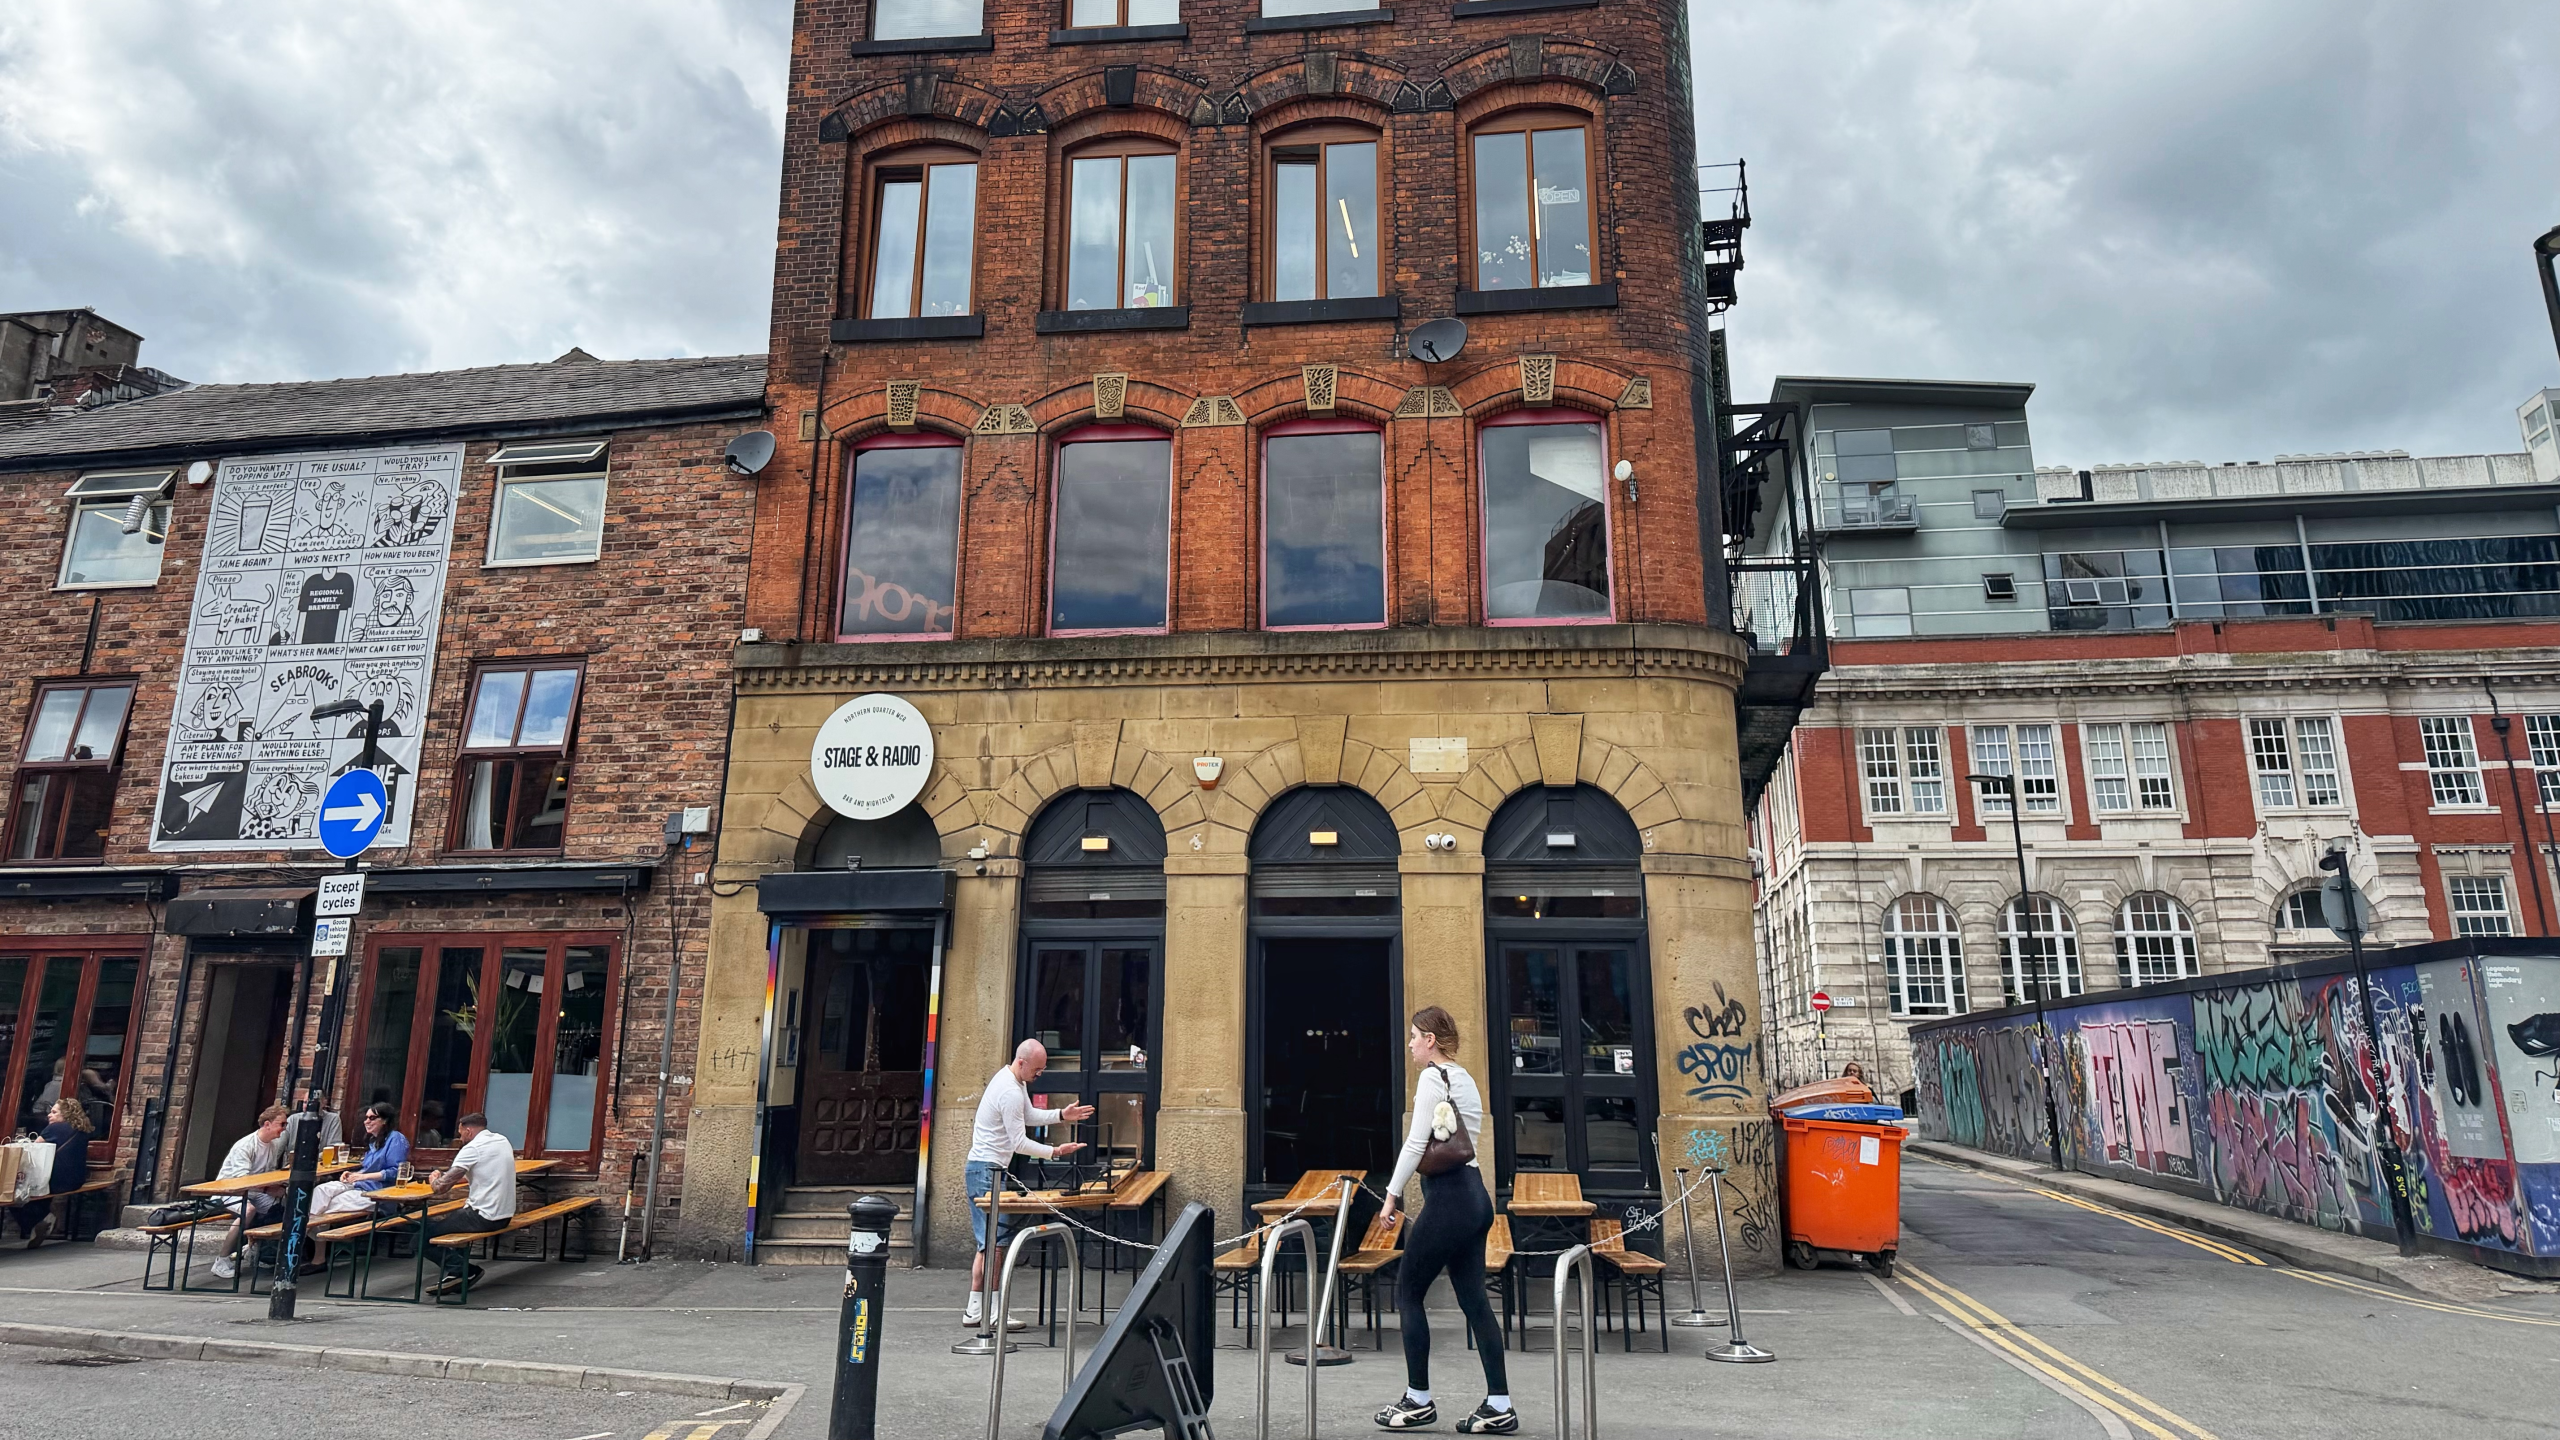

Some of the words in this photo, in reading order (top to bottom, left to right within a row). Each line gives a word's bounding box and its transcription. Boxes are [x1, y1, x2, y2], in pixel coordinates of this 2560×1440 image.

[1546, 190, 1578, 202] OPEN
[384, 457, 409, 466] WOULD
[410, 456, 424, 464] YOU
[260, 464, 281, 472] WANT
[311, 463, 329, 473] THE
[331, 462, 366, 472] USUAL?
[399, 462, 428, 471] TRAY?
[232, 472, 268, 480] TOPPING
[402, 476, 416, 484] okay
[262, 482, 288, 492] perfect
[304, 480, 316, 488] Yes
[309, 538, 328, 547] seen!
[337, 536, 360, 545] exist!
[294, 555, 320, 564] WHO'S
[322, 553, 350, 562] NEXT?
[364, 552, 382, 560] HOW
[383, 551, 402, 559] HAVE
[403, 550, 417, 558] YOU
[418, 549, 440, 558] BEEN?
[218, 560, 240, 568] SAME
[242, 558, 272, 567] AGAIN?
[286, 572, 296, 580] He
[368, 566, 392, 576] Can't
[395, 566, 426, 576] complain
[213, 575, 236, 583] Please
[282, 586, 300, 596] first
[309, 588, 344, 596] REGIONAL
[313, 596, 338, 604] FAMILY
[224, 602, 260, 614] Creature
[224, 614, 234, 628] of
[234, 612, 258, 624] habit
[368, 628, 389, 636] Makes
[396, 628, 420, 636] change
[270, 648, 298, 658] WHAT'S
[300, 648, 315, 656] HER
[316, 646, 346, 656] NAME?
[348, 646, 368, 654] WHAT
[369, 646, 384, 654] CAN
[390, 644, 406, 652] GET
[197, 656, 214, 664] TRY
[216, 654, 258, 663] ANYTHING?
[350, 660, 365, 669] Have
[366, 662, 378, 670] you
[380, 660, 390, 669] got
[392, 660, 419, 668] anything
[191, 668, 216, 677] Staying
[240, 666, 257, 674] hotel
[201, 674, 220, 682] would
[270, 664, 338, 692] SEABROOKS
[844, 707, 870, 724] NORTHERN
[872, 706, 896, 716] QUARTER
[896, 712, 907, 722] MCR
[184, 730, 214, 740] literally
[181, 744, 199, 752] ANY
[262, 742, 288, 750] WOULD
[180, 752, 198, 760] THE
[200, 752, 242, 760] EVENING?
[258, 750, 300, 758] ANYTHING
[302, 749, 325, 758] ELSE?
[824, 746, 862, 768] STAGE
[865, 746, 879, 767] &
[882, 744, 920, 767] RADIO
[176, 764, 186, 772] See
[221, 763, 240, 772] night
[256, 764, 270, 772] have
[272, 764, 304, 772] everything
[174, 772, 194, 780] takes
[842, 794, 852, 804] BAR
[854, 798, 864, 808] AND
[866, 793, 896, 807] NIGHTCLUB
[323, 880, 360, 894] Except
[322, 896, 356, 911] cycles
[2486, 966, 2520, 974] Legendary
[2488, 976, 2522, 984] Legendary
